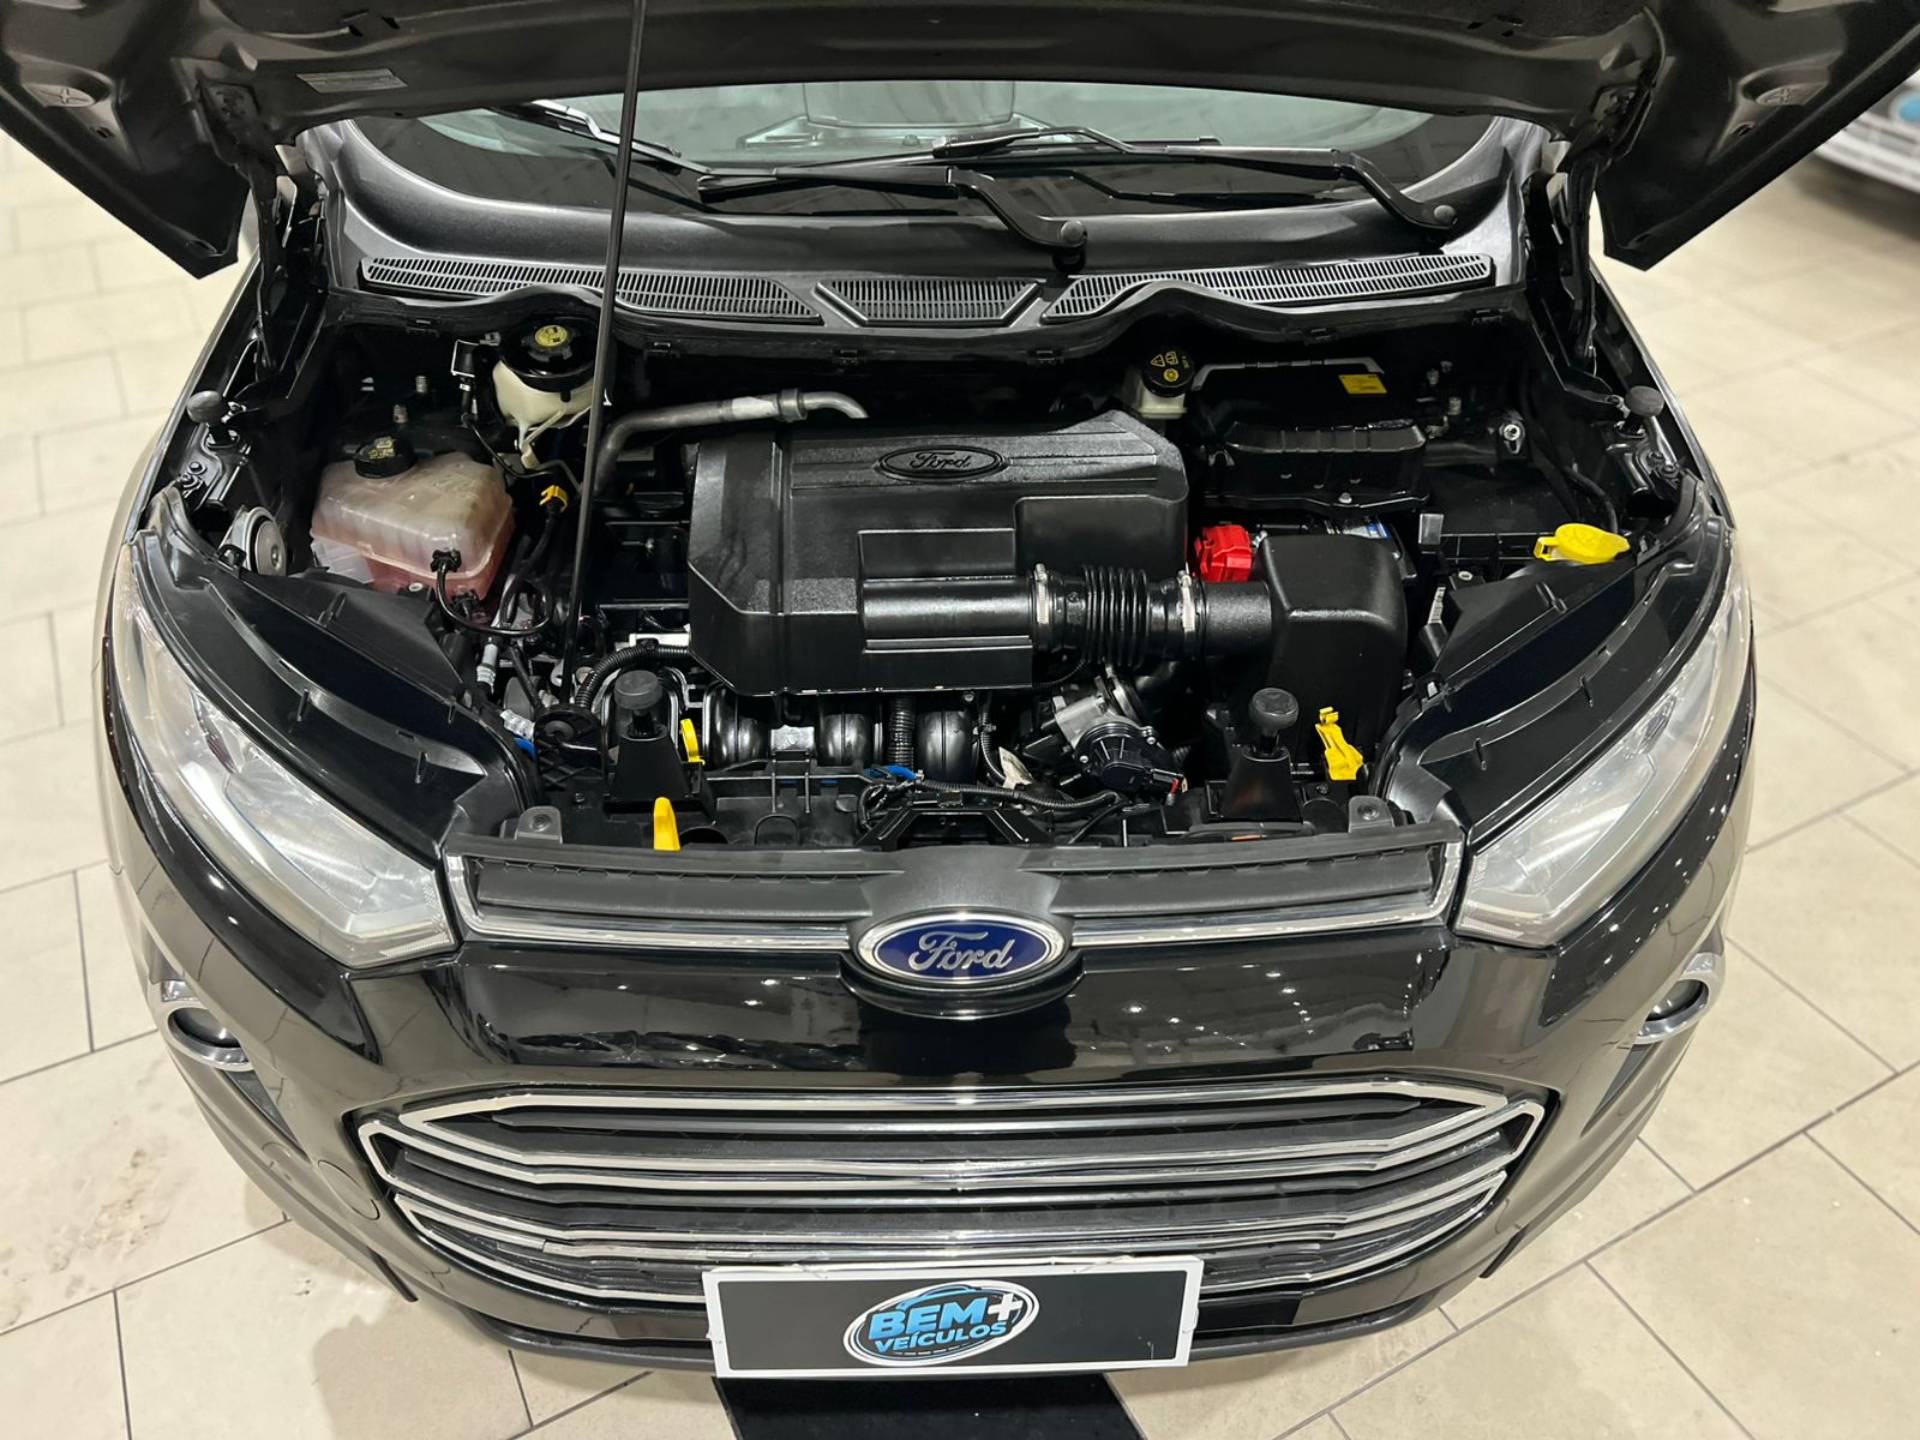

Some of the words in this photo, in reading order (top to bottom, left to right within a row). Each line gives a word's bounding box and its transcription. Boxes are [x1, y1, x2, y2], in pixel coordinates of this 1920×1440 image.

[909, 450, 972, 469] Ford
[908, 931, 1015, 971] Ford
[874, 1322, 1008, 1354] VEÍCULOS
